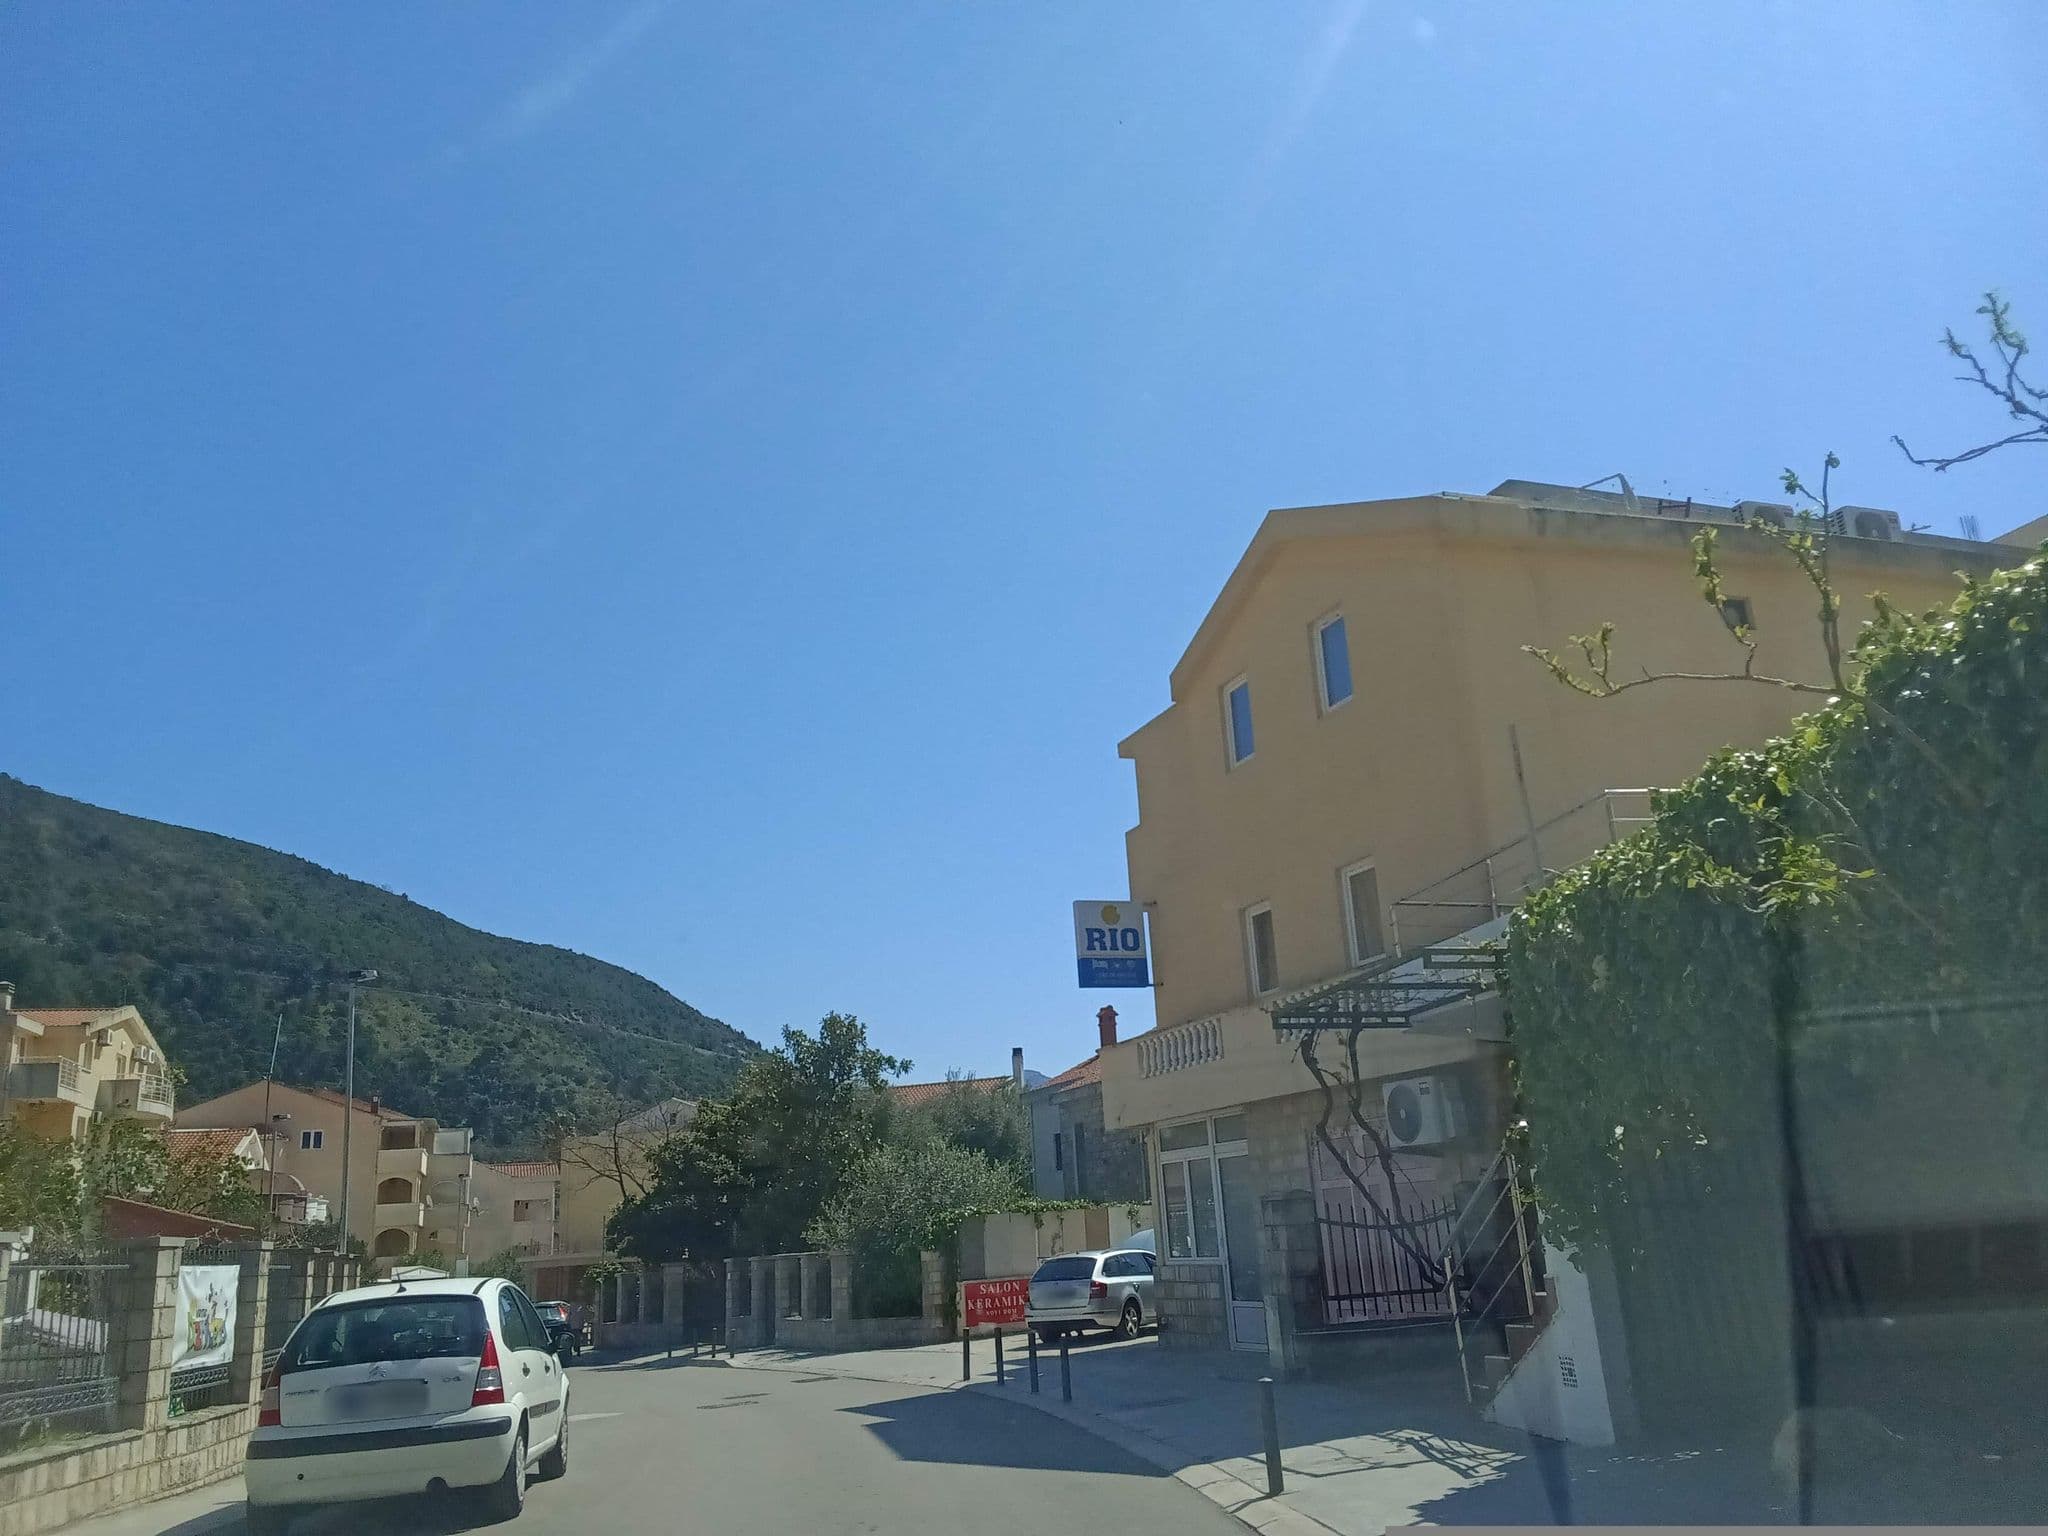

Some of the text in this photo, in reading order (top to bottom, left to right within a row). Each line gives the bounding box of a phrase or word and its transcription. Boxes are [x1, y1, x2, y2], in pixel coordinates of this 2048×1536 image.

[1085, 928, 1140, 951] RIO
[980, 1281, 1020, 1294] SALON
[968, 1295, 1025, 1310] KERAMIK
